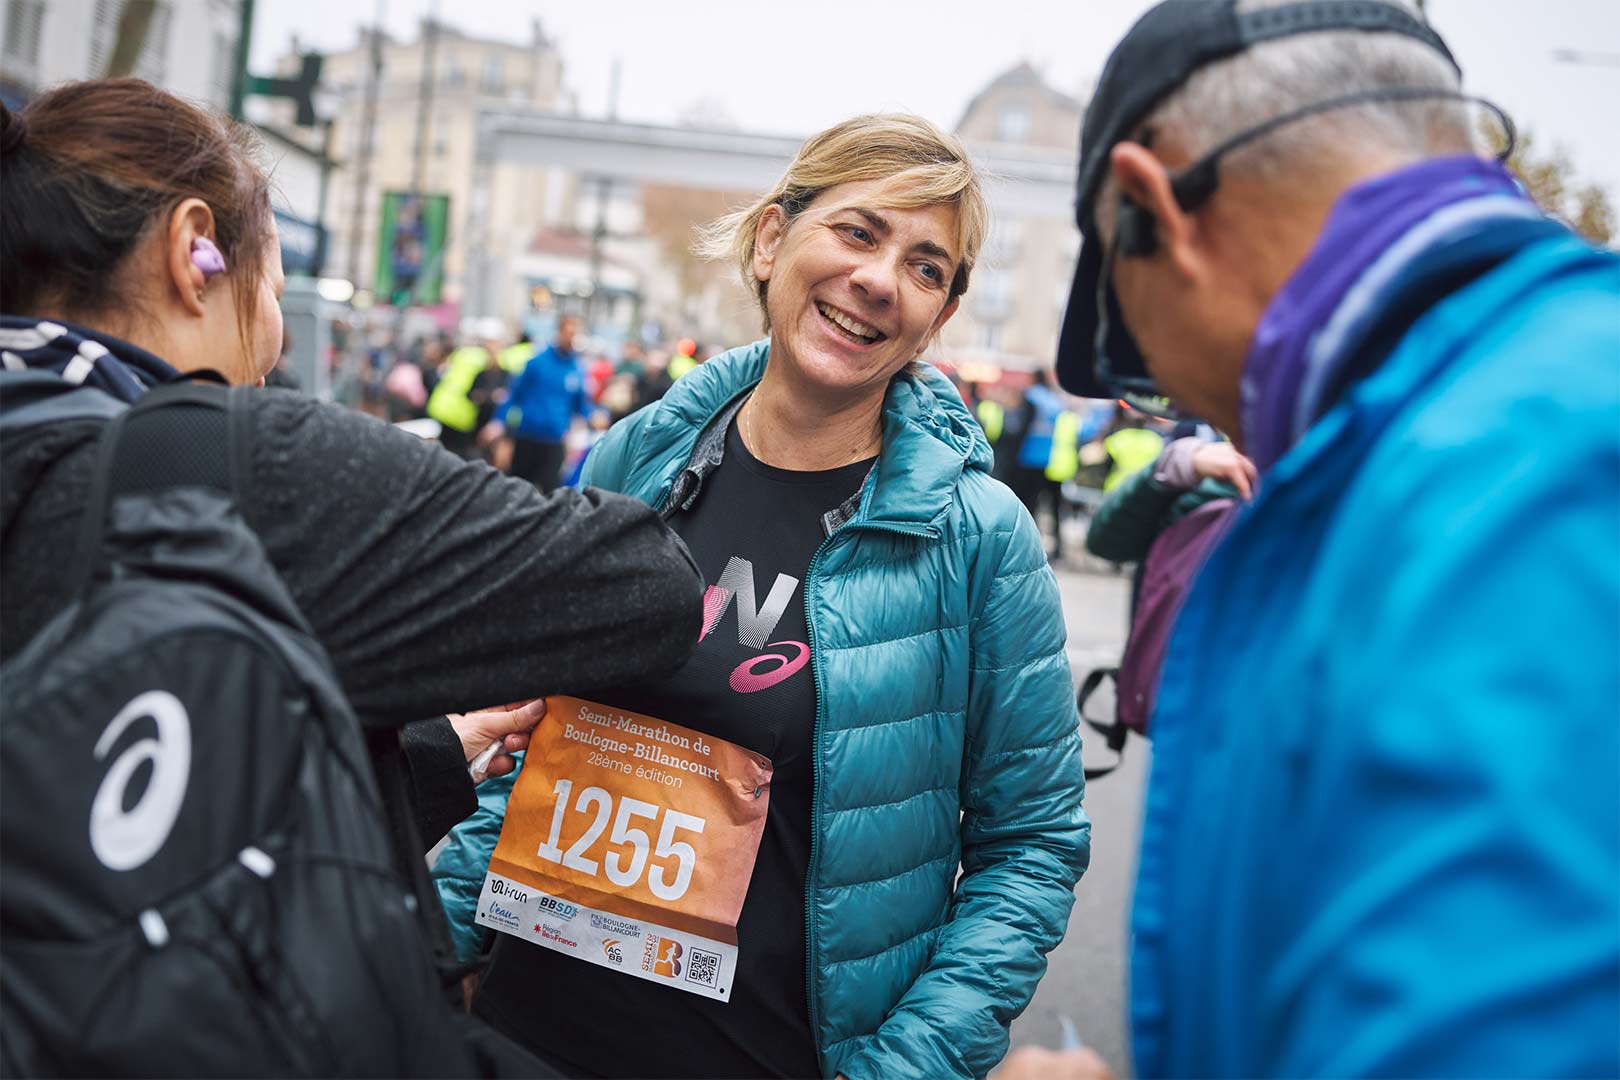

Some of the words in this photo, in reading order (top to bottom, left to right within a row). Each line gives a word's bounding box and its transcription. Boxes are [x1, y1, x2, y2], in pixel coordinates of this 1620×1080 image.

[578, 706, 690, 750] Semi-Marathon
[693, 737, 711, 756] de
[564, 723, 720, 781] Boulogne-Billancourt
[587, 751, 633, 775] 28ème
[635, 764, 683, 789] édition
[537, 779, 706, 901] 1255
[503, 883, 528, 904] i-run
[539, 897, 572, 915] BBSD
[602, 924, 641, 939] BILLANCOURT
[603, 917, 641, 931] BOULOGNE-
[607, 946, 622, 956] AC
[608, 953, 623, 963] BB
[641, 942, 654, 972] SEMI
